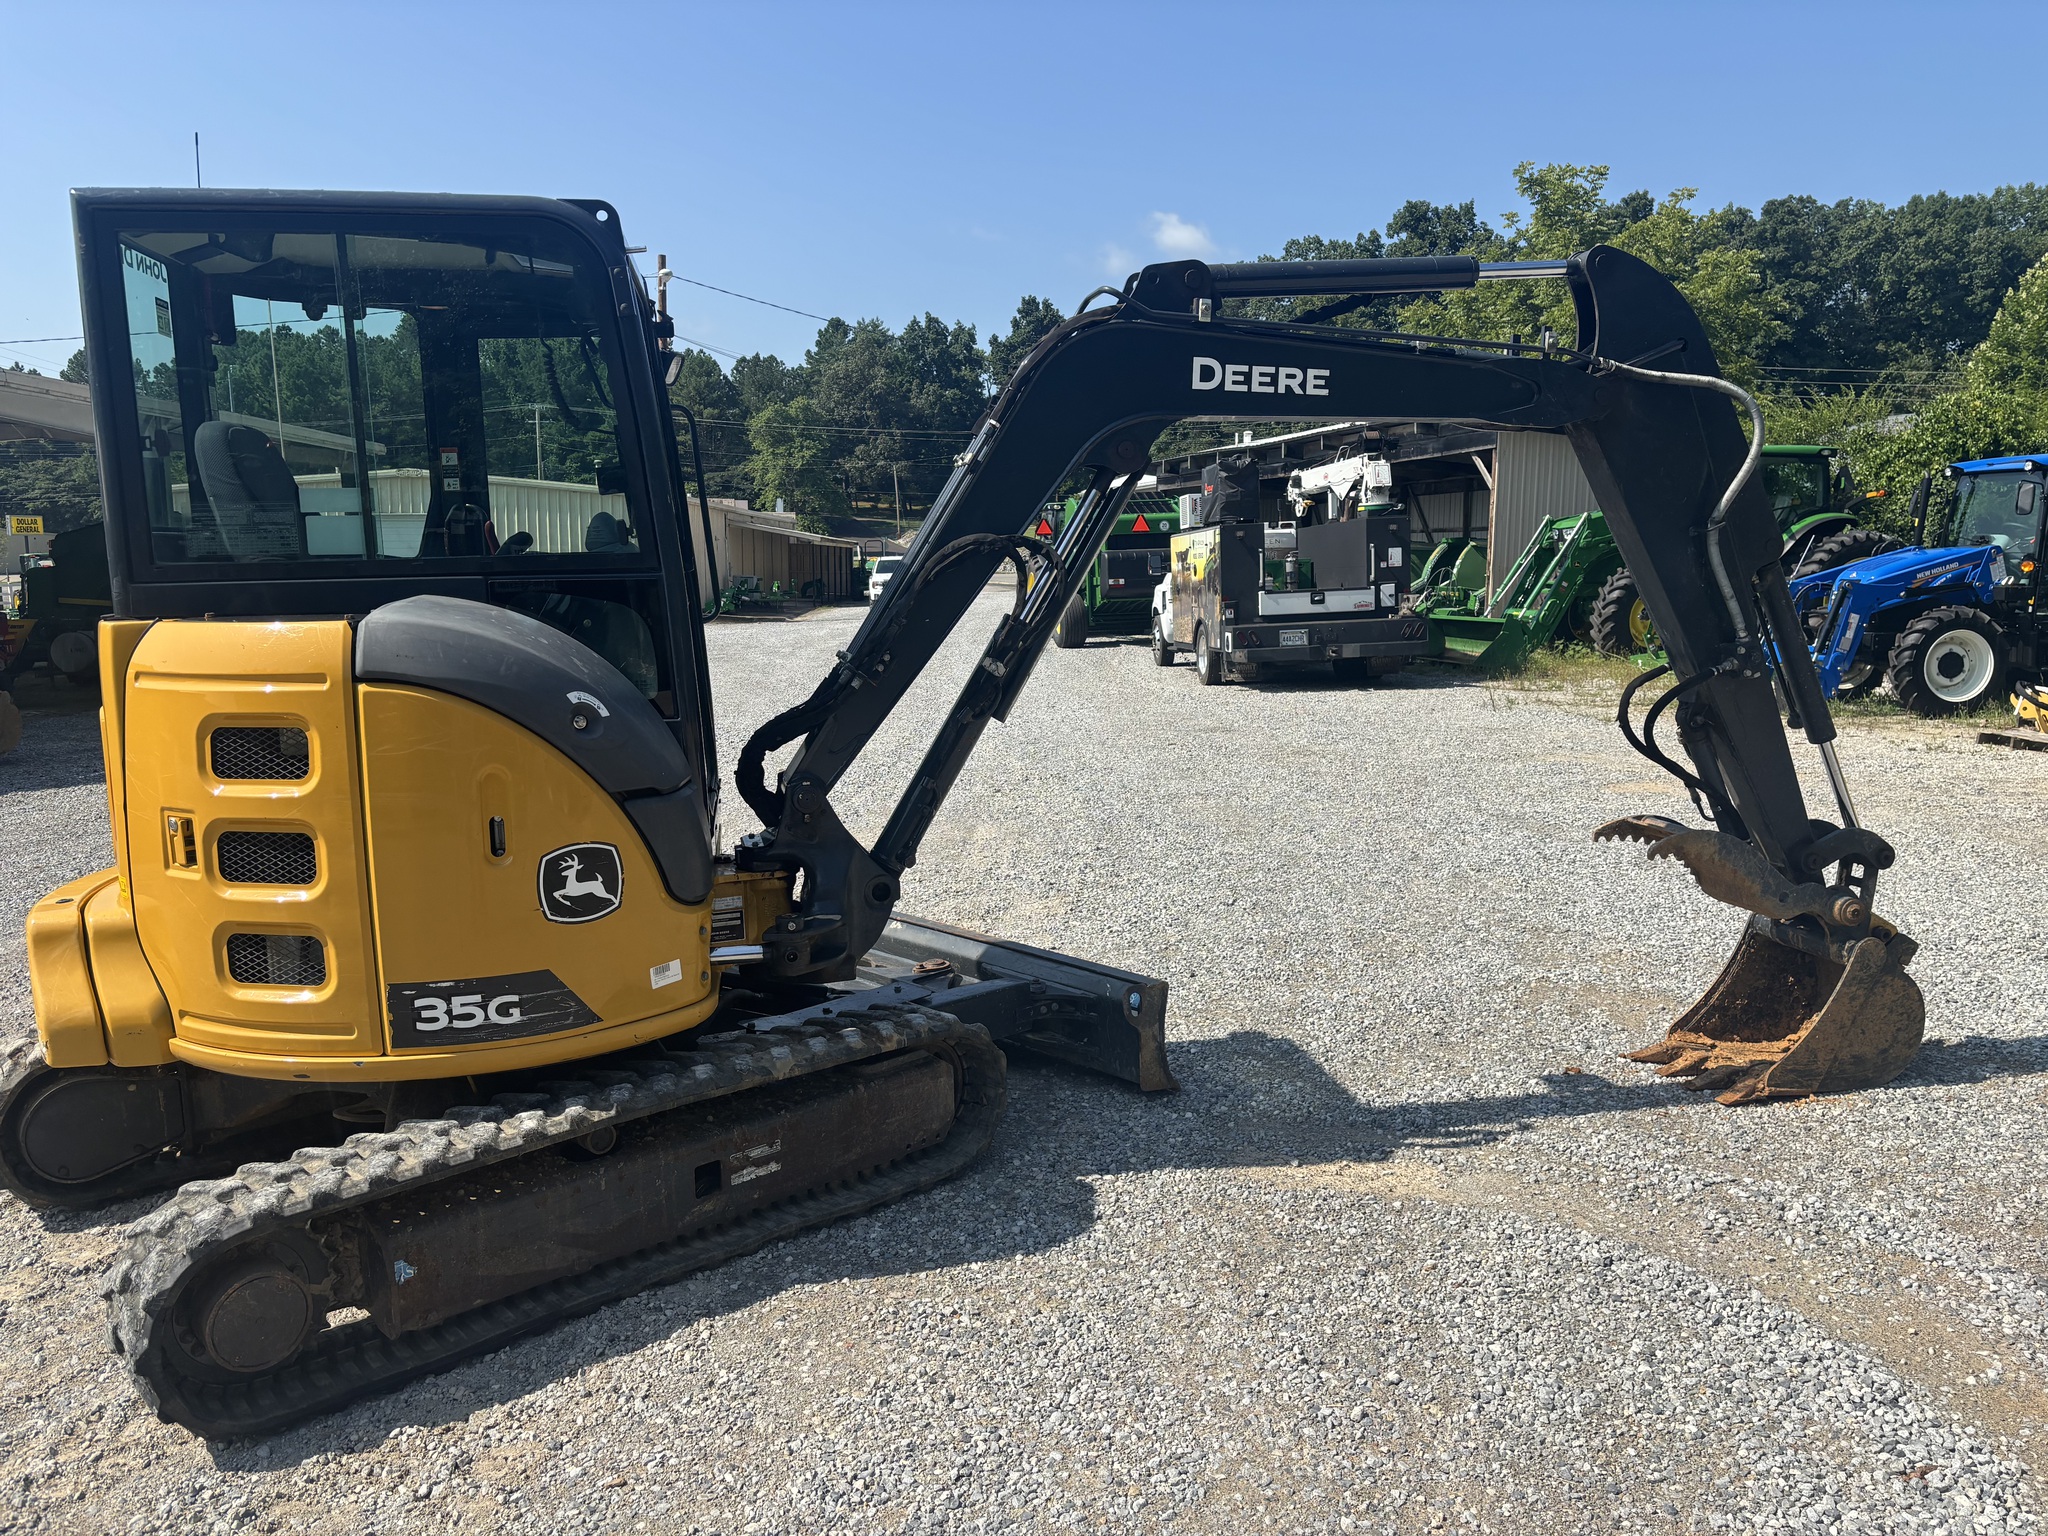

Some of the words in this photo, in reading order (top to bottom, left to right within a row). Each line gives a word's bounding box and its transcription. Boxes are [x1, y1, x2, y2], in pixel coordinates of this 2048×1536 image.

[1192, 356, 1330, 395] DEERE
[16, 518, 38, 526] DOLLAR
[1916, 569, 1931, 579] NEW
[1931, 561, 1959, 574] HOLLAND
[414, 994, 521, 1031] 35G
